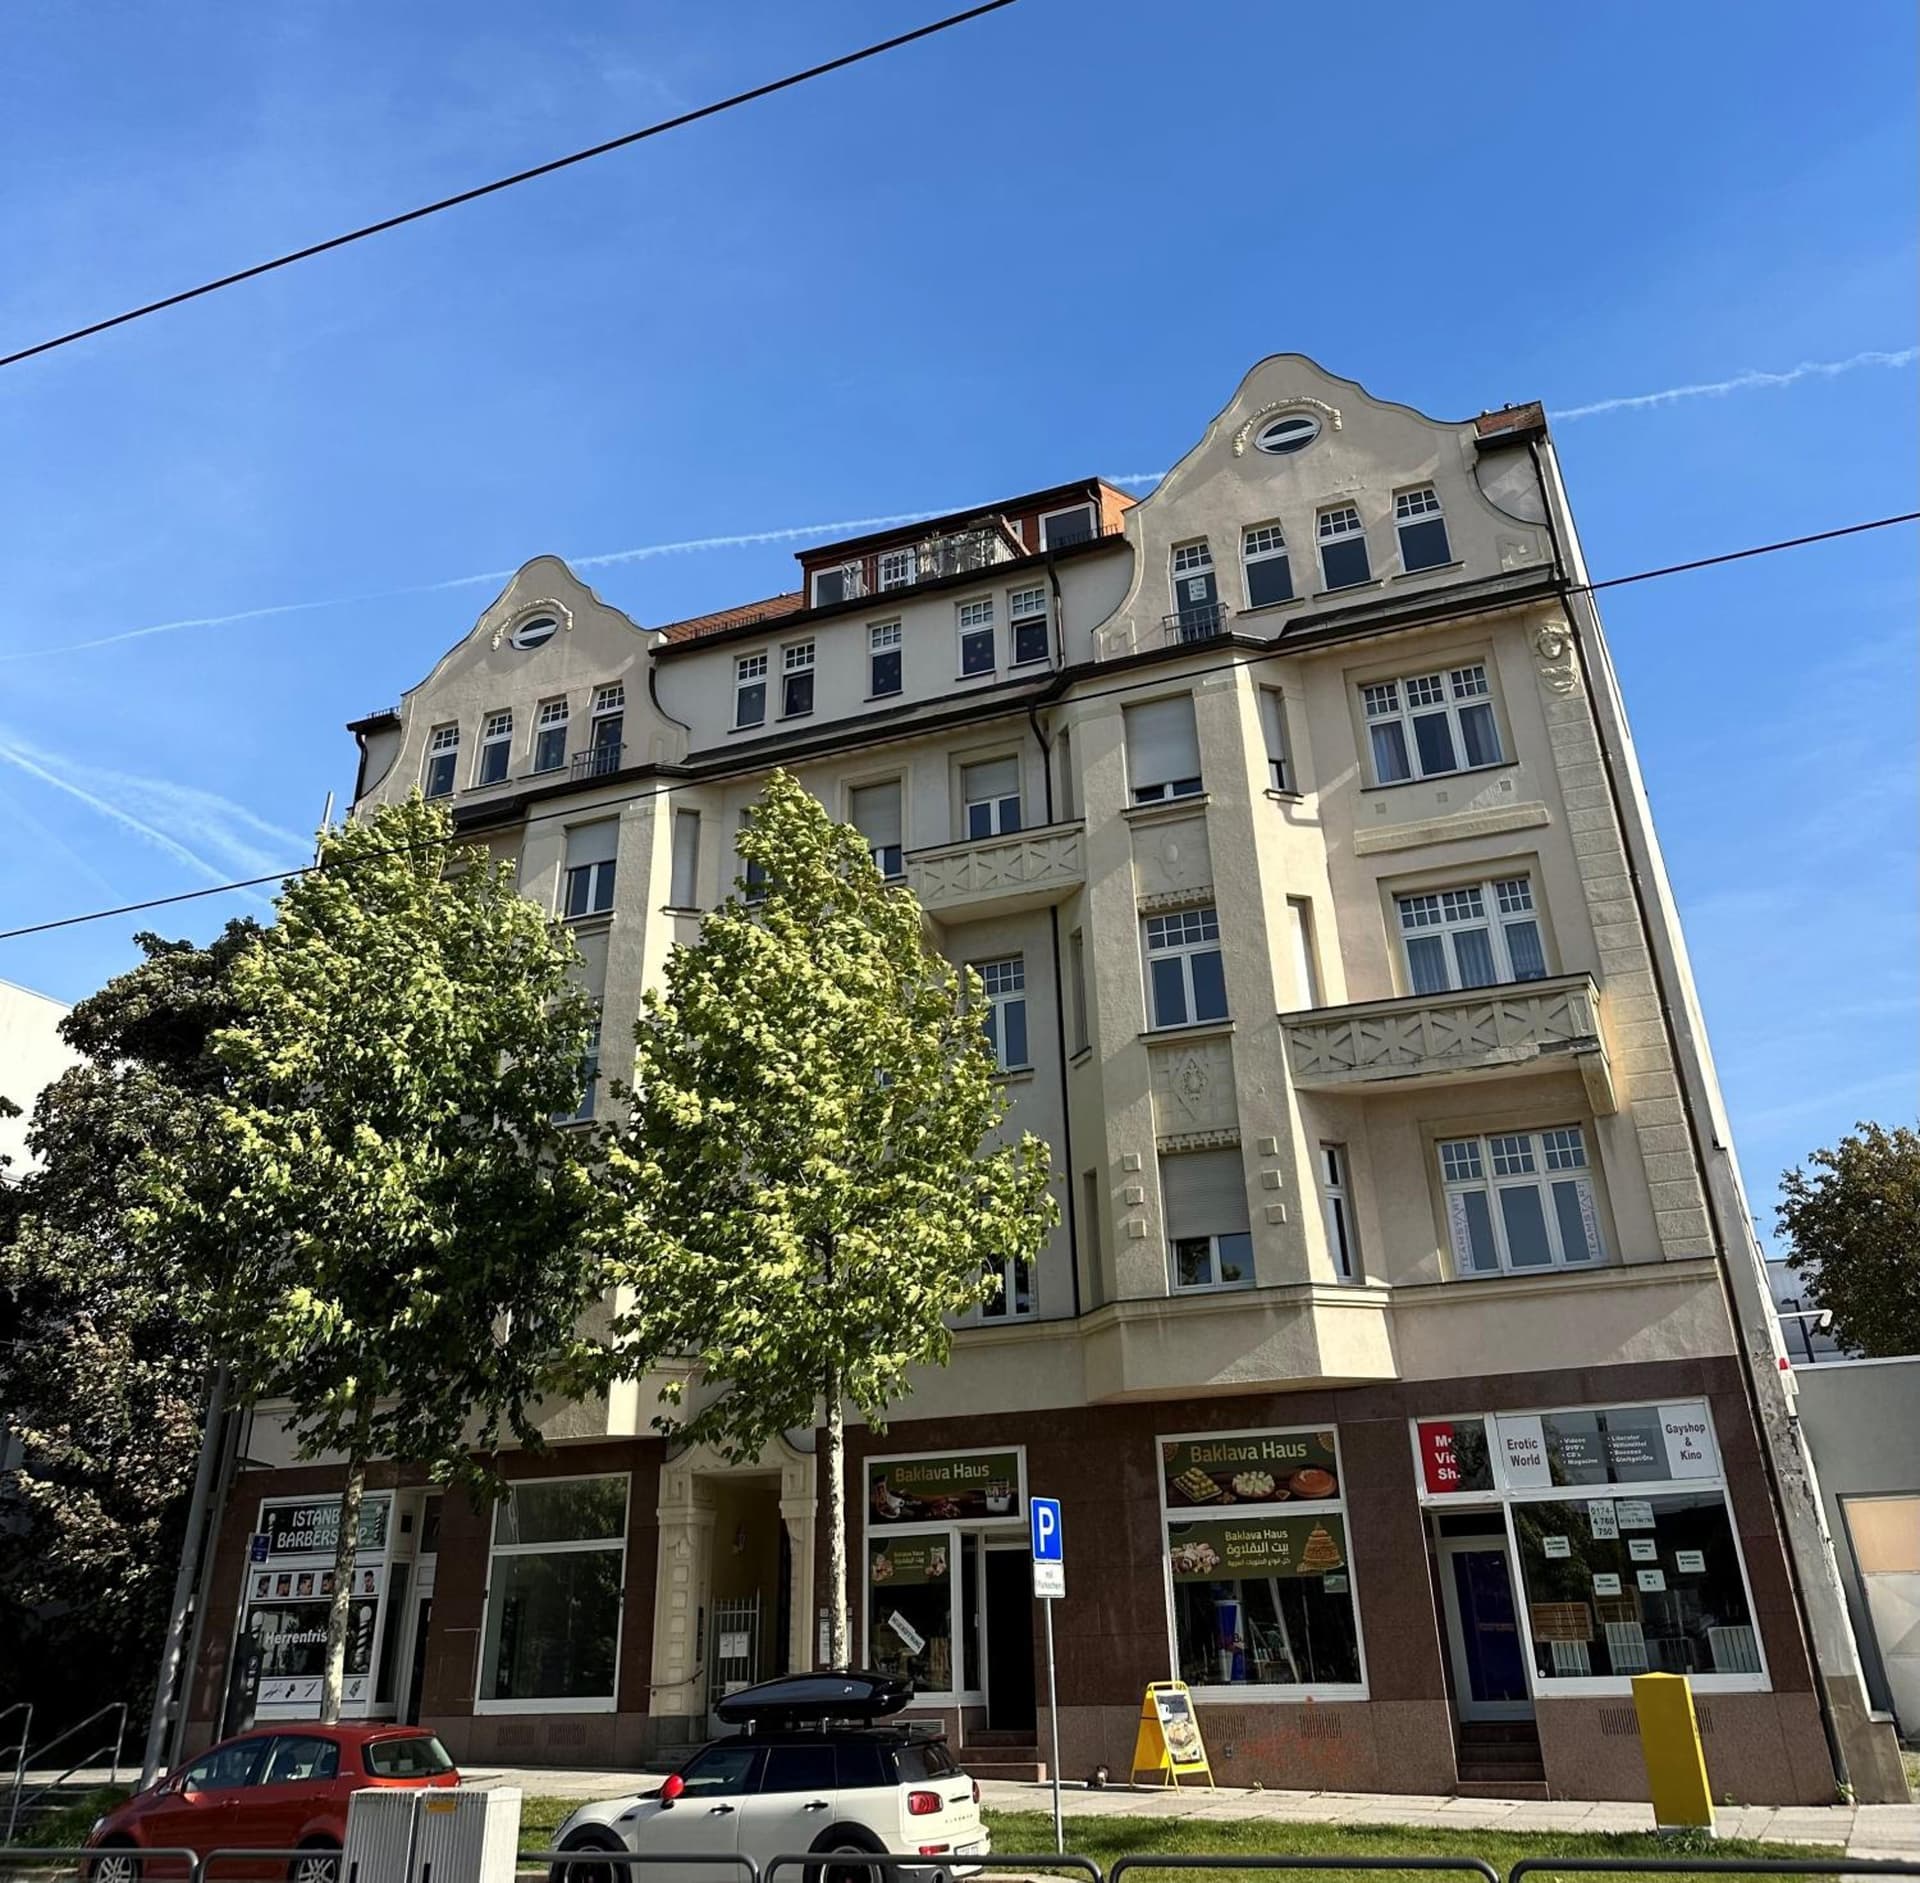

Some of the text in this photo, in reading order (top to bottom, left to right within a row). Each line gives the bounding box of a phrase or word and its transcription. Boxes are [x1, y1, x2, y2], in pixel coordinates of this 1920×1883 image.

[1665, 1422, 1706, 1436] Gayshop
[1507, 1437, 1538, 1450] Erotic
[1684, 1437, 1693, 1447] &
[1190, 1440, 1308, 1463] Baklava Haus
[1510, 1453, 1541, 1466] World
[1680, 1450, 1703, 1460] Kino
[895, 1463, 990, 1483] Baklava Haus
[292, 1508, 341, 1528] ISTANB
[277, 1526, 368, 1549] BARBERSP
[1039, 1506, 1055, 1553] P
[1225, 1528, 1289, 1541] Baklava Haus
[1226, 1541, 1290, 1558] بيت البقلاوة
[264, 1628, 329, 1645] Herrenfris
